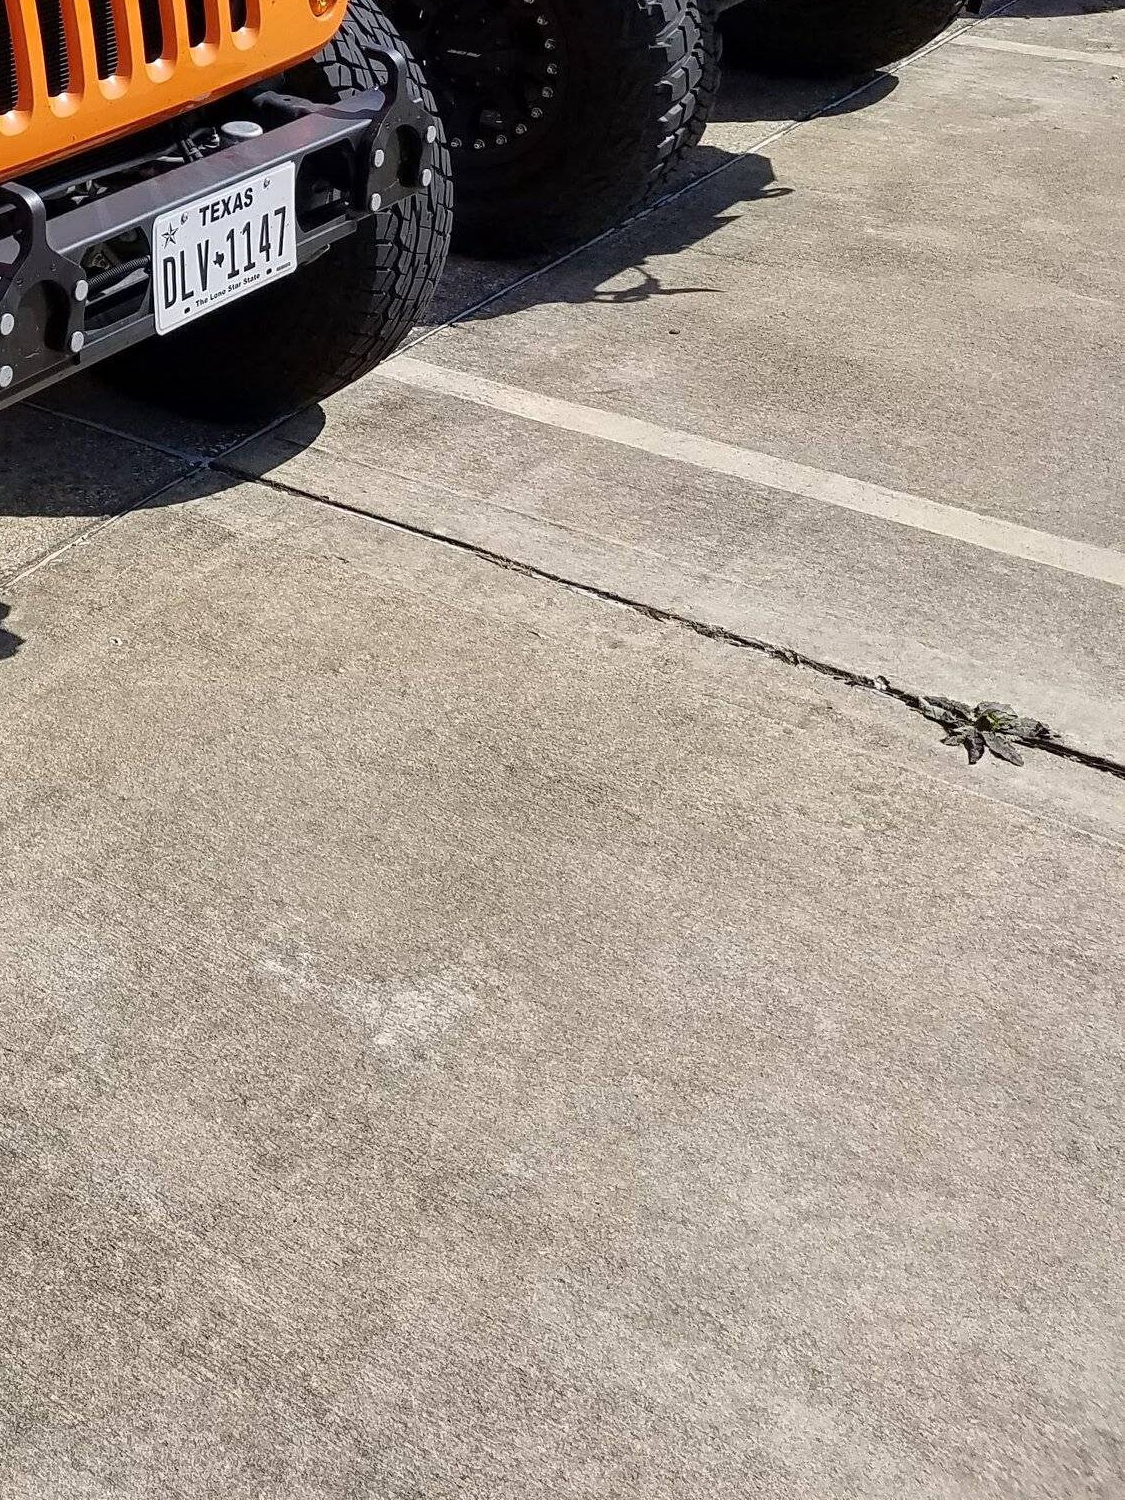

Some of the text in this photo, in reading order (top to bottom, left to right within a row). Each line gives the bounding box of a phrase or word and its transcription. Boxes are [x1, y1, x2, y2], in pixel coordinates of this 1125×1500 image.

[199, 187, 254, 227] TEXAS
[195, 273, 261, 307] The Lone Star State
